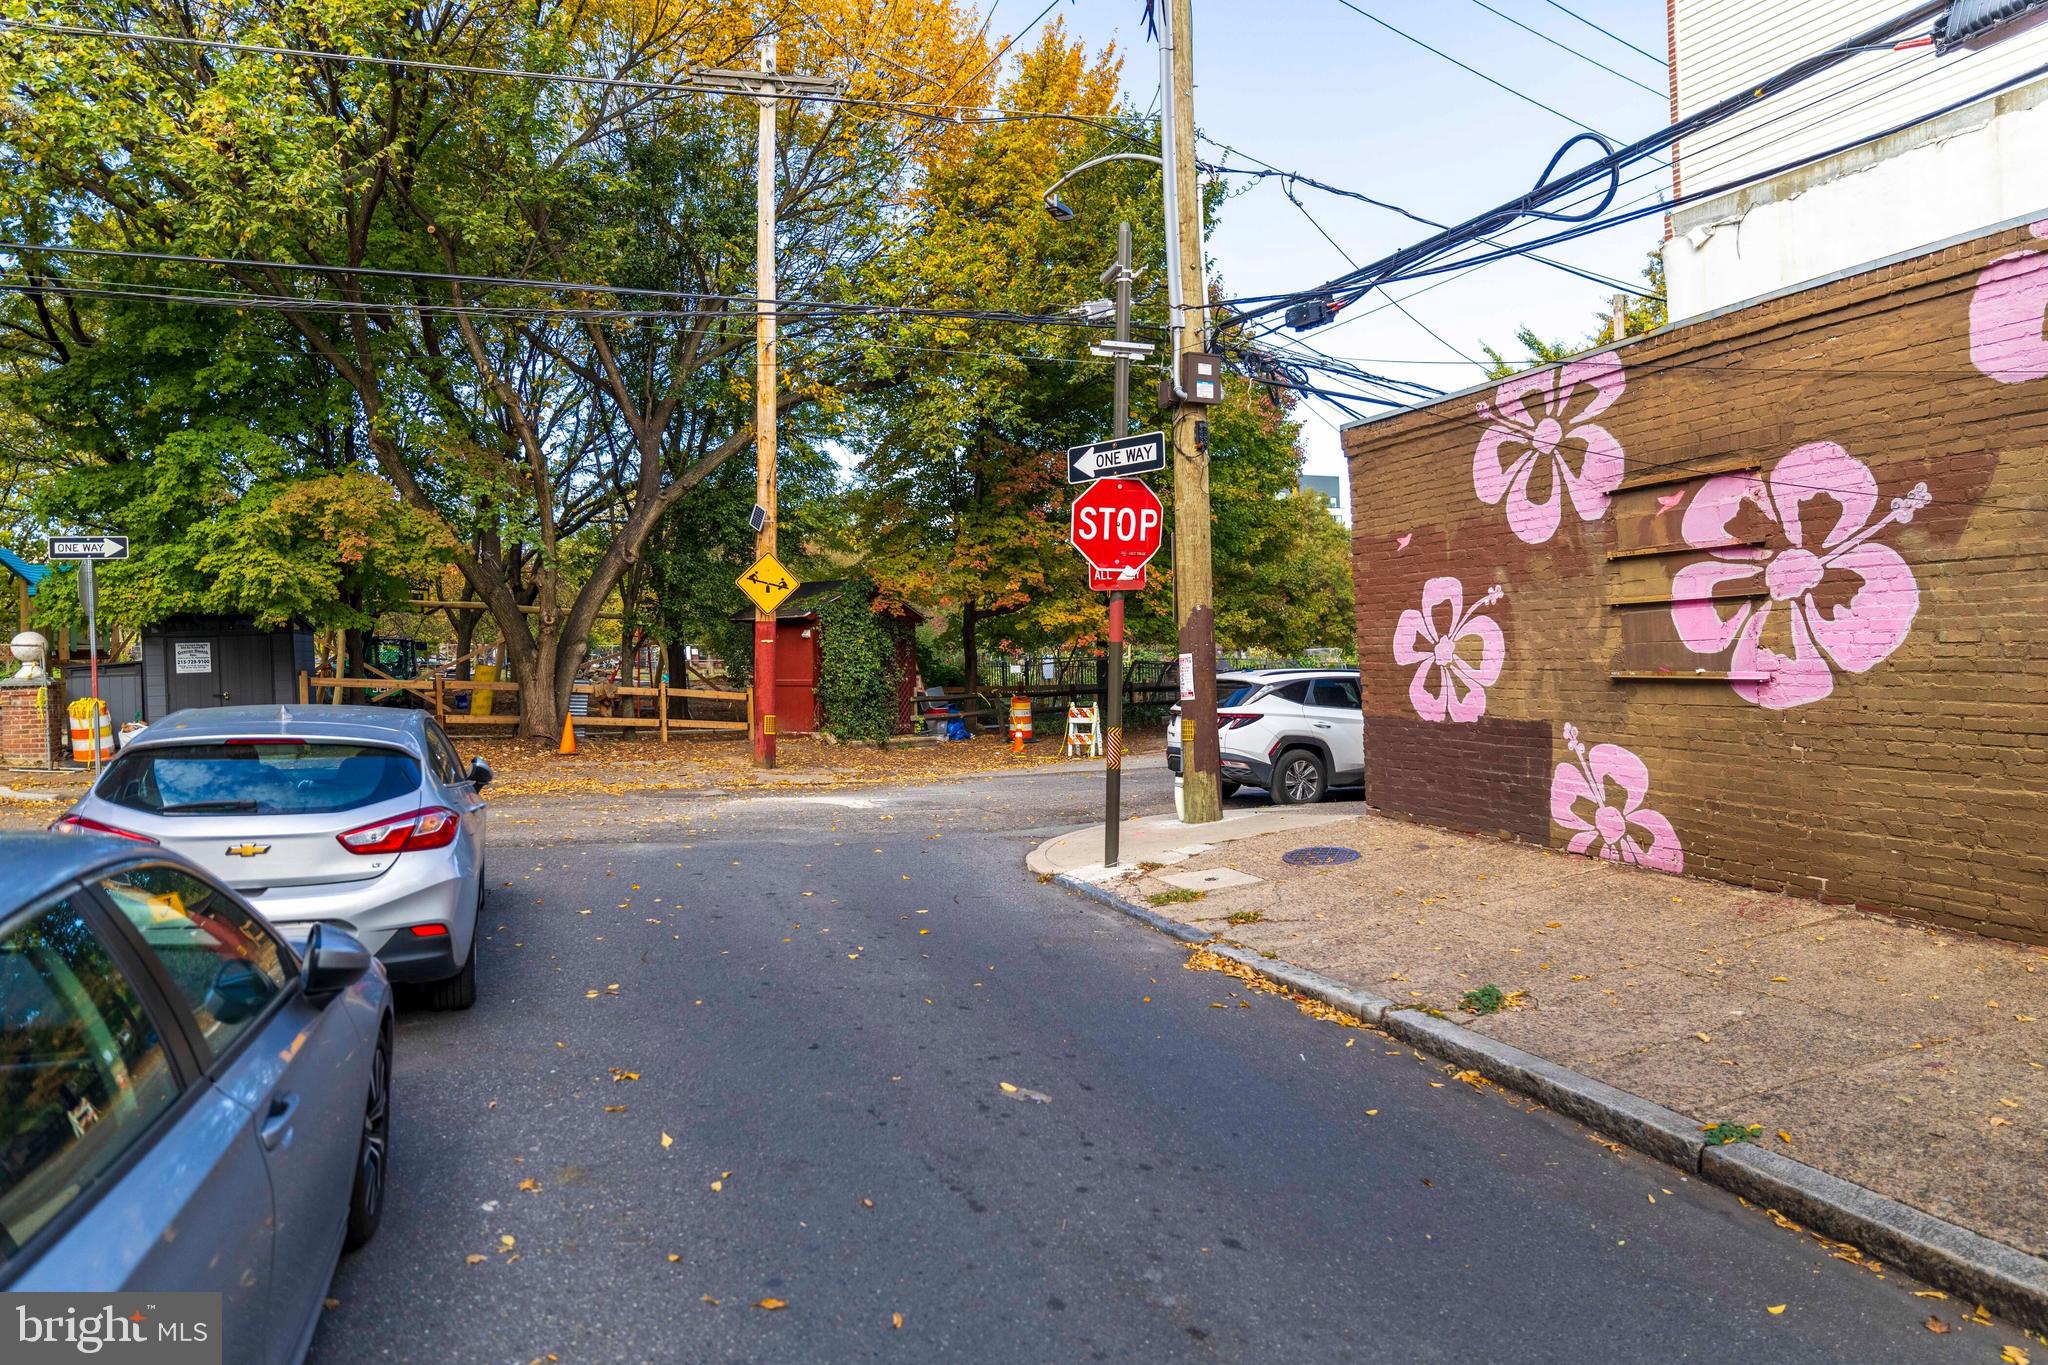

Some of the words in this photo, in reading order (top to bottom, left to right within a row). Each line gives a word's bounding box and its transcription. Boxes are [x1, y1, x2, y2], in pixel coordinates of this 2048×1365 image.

[1096, 451, 1121, 468] ONE
[1126, 445, 1153, 462] WAY
[1078, 506, 1158, 542] STOP
[57, 543, 79, 552] ONE
[82, 543, 104, 552] WAY
[1094, 570, 1112, 580] ALL
